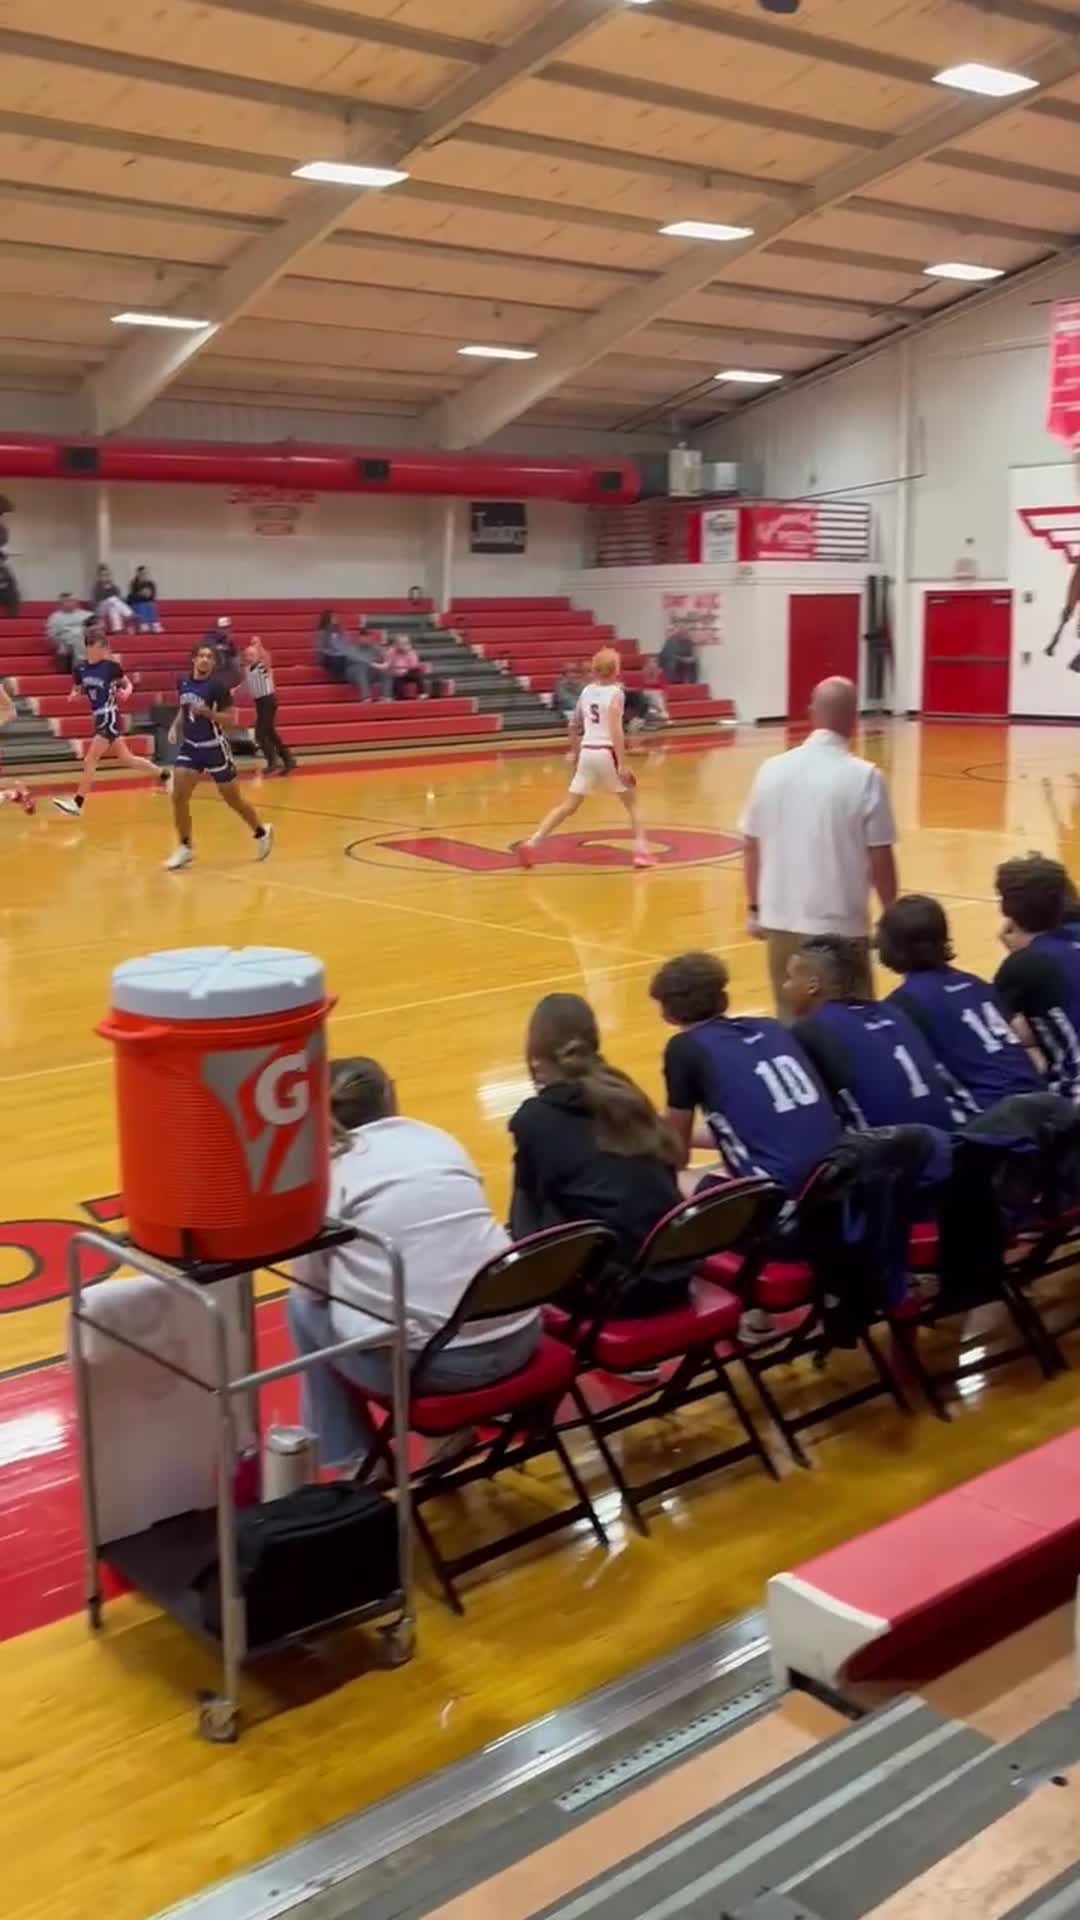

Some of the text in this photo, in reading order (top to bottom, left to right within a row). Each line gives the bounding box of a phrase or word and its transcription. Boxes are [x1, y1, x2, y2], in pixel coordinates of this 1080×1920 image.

[960, 1001, 1022, 1054] 14
[254, 1051, 311, 1127] G
[754, 1054, 820, 1114] 10
[893, 1044, 931, 1099] 1
